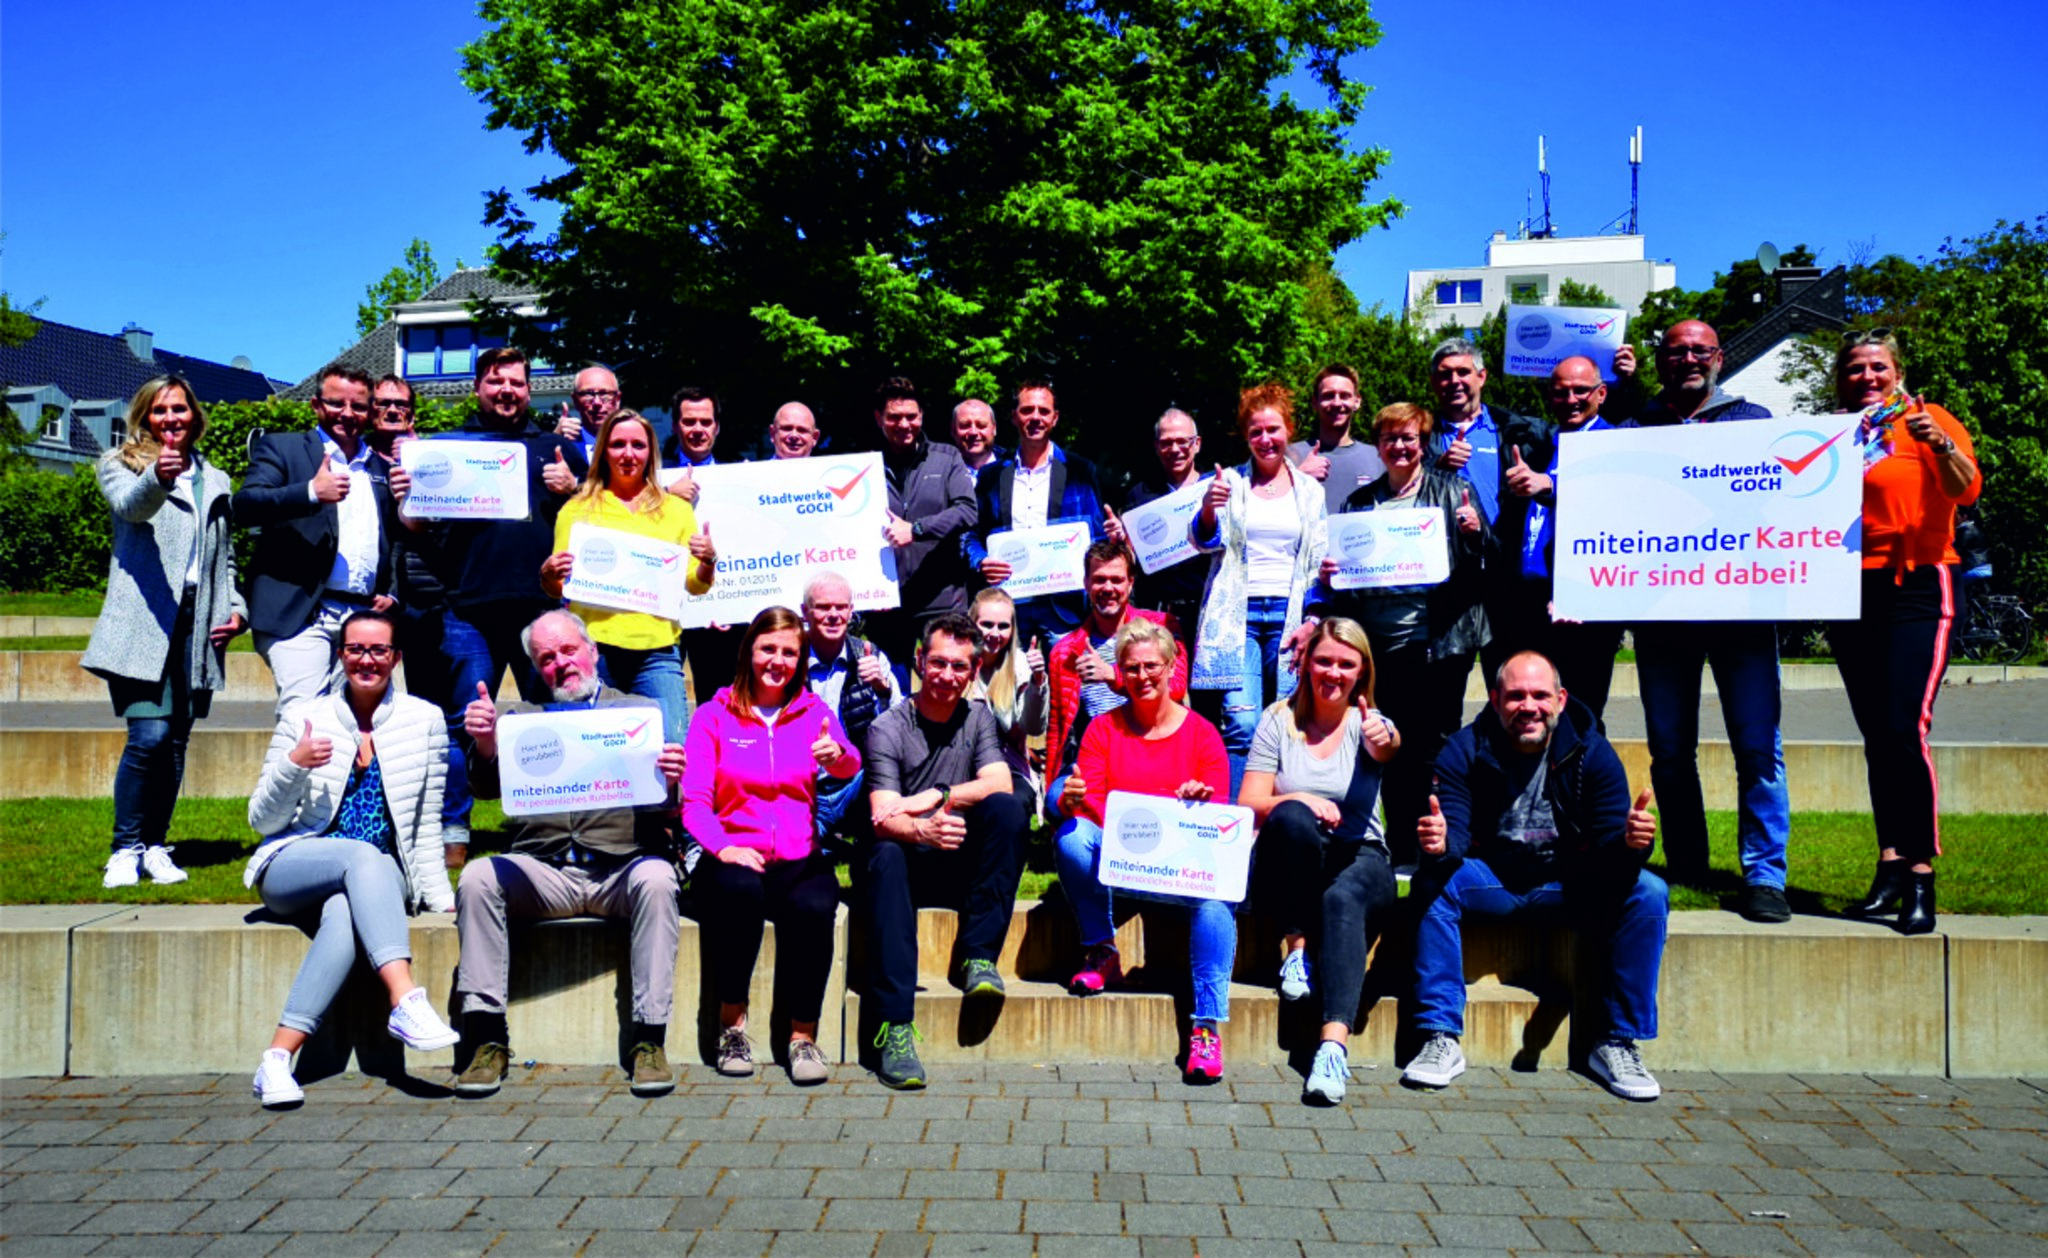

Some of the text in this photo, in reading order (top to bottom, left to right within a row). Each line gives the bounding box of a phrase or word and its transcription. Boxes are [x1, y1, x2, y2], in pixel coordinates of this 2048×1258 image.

[1681, 461, 1782, 479] Stadtwerke
[1730, 477, 1782, 492] GOCH
[410, 493, 501, 504] miteinander Karte
[758, 490, 832, 506] Stadtwerke
[796, 502, 834, 515] GOCH
[1573, 526, 1842, 555] miteinander Karte
[716, 545, 857, 573] einander Karte
[1397, 561, 1424, 571] Karte
[739, 573, 777, 586] 012015
[1589, 560, 1808, 588] Wir sind dabei!
[571, 577, 658, 601] miteinander Karte
[853, 589, 870, 600] ind
[603, 739, 627, 747] GOCH
[512, 778, 630, 798] miteinander Karte
[1109, 858, 1214, 881] miteinander Karte
